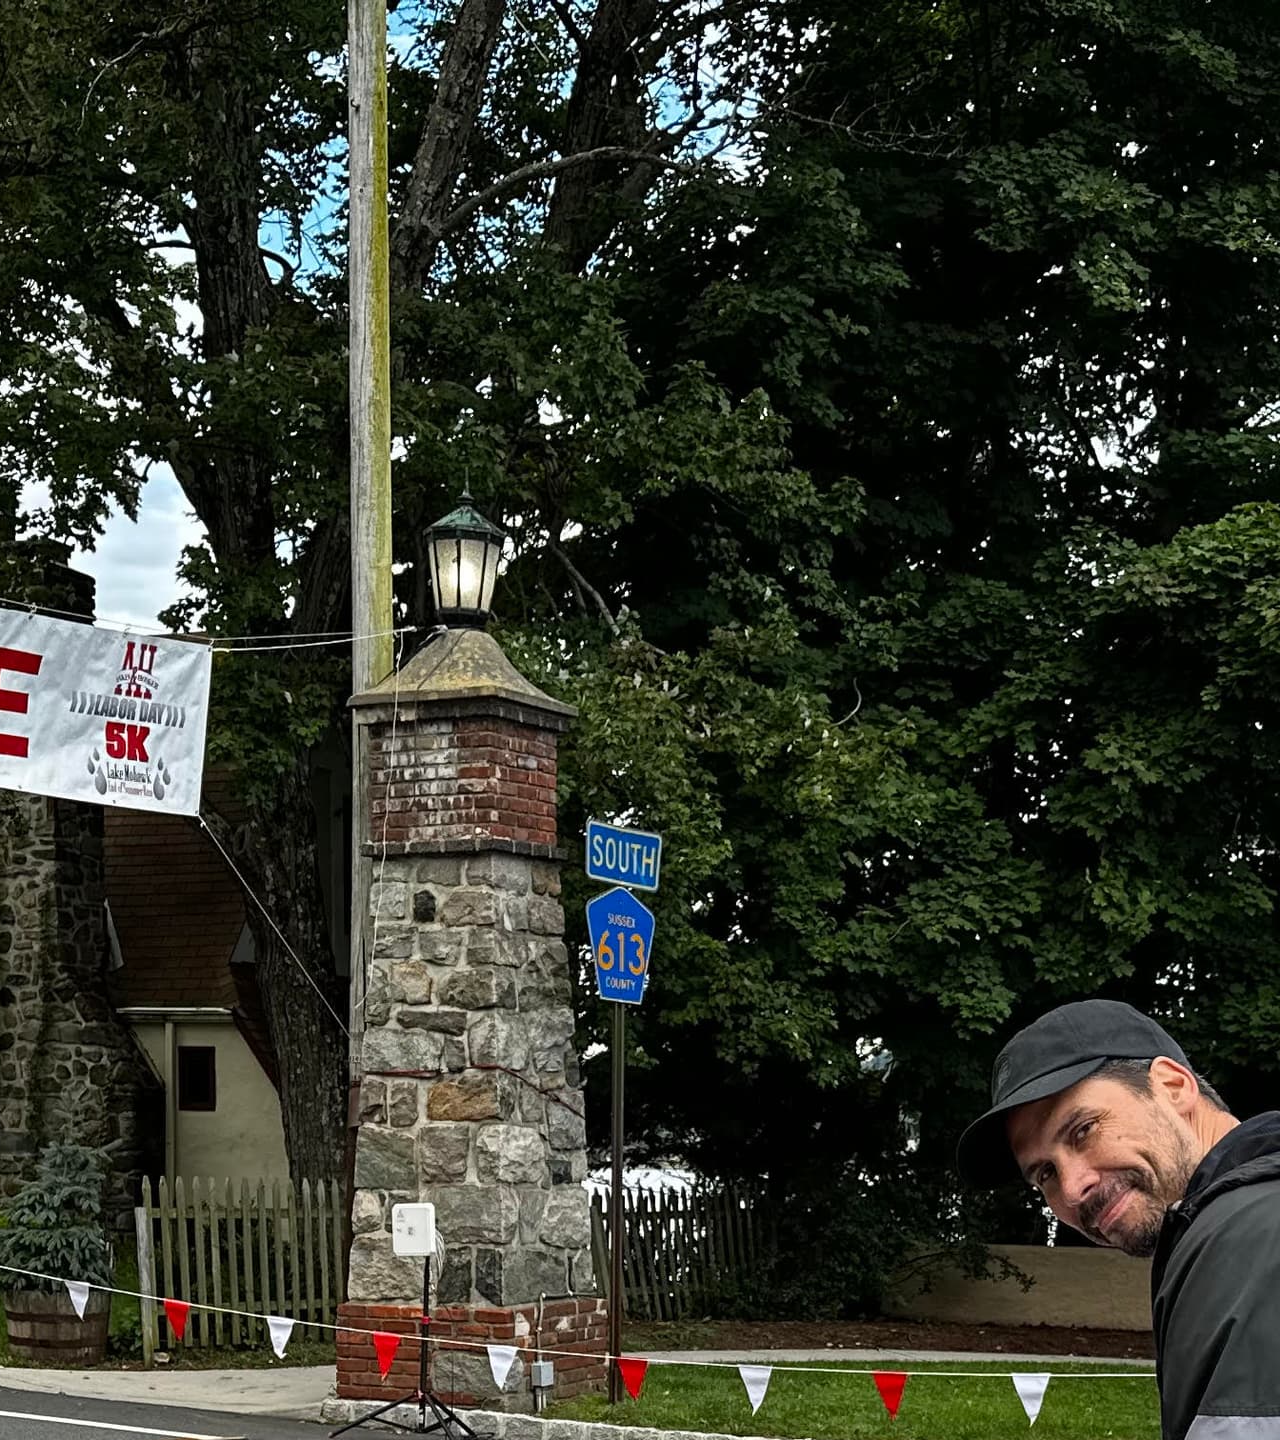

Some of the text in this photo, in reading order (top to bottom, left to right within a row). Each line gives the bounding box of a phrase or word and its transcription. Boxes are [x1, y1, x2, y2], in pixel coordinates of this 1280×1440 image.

[94, 694, 166, 725] LABOR DAY
[105, 720, 150, 763] 5K
[106, 762, 124, 781] Lake
[592, 834, 656, 878] SOUTH
[607, 912, 636, 929] SUSSEX
[597, 929, 646, 976] 613
[605, 975, 636, 991] COUNTY
